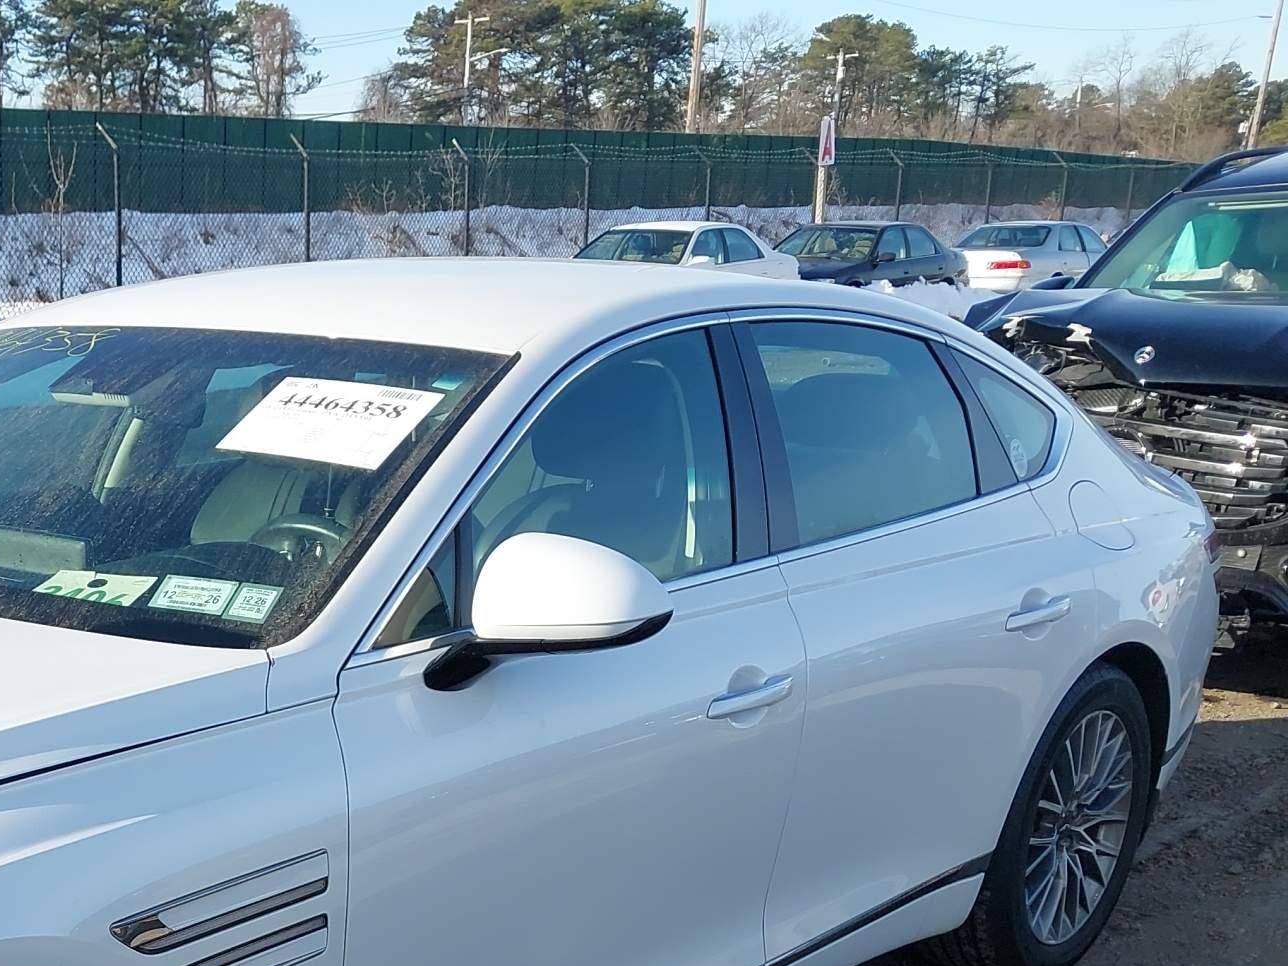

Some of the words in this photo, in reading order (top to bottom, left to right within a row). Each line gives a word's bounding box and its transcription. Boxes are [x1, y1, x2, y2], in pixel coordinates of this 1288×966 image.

[822, 119, 833, 161] A
[279, 392, 408, 419] 44464358
[162, 589, 177, 600] 12
[204, 594, 221, 605] 26
